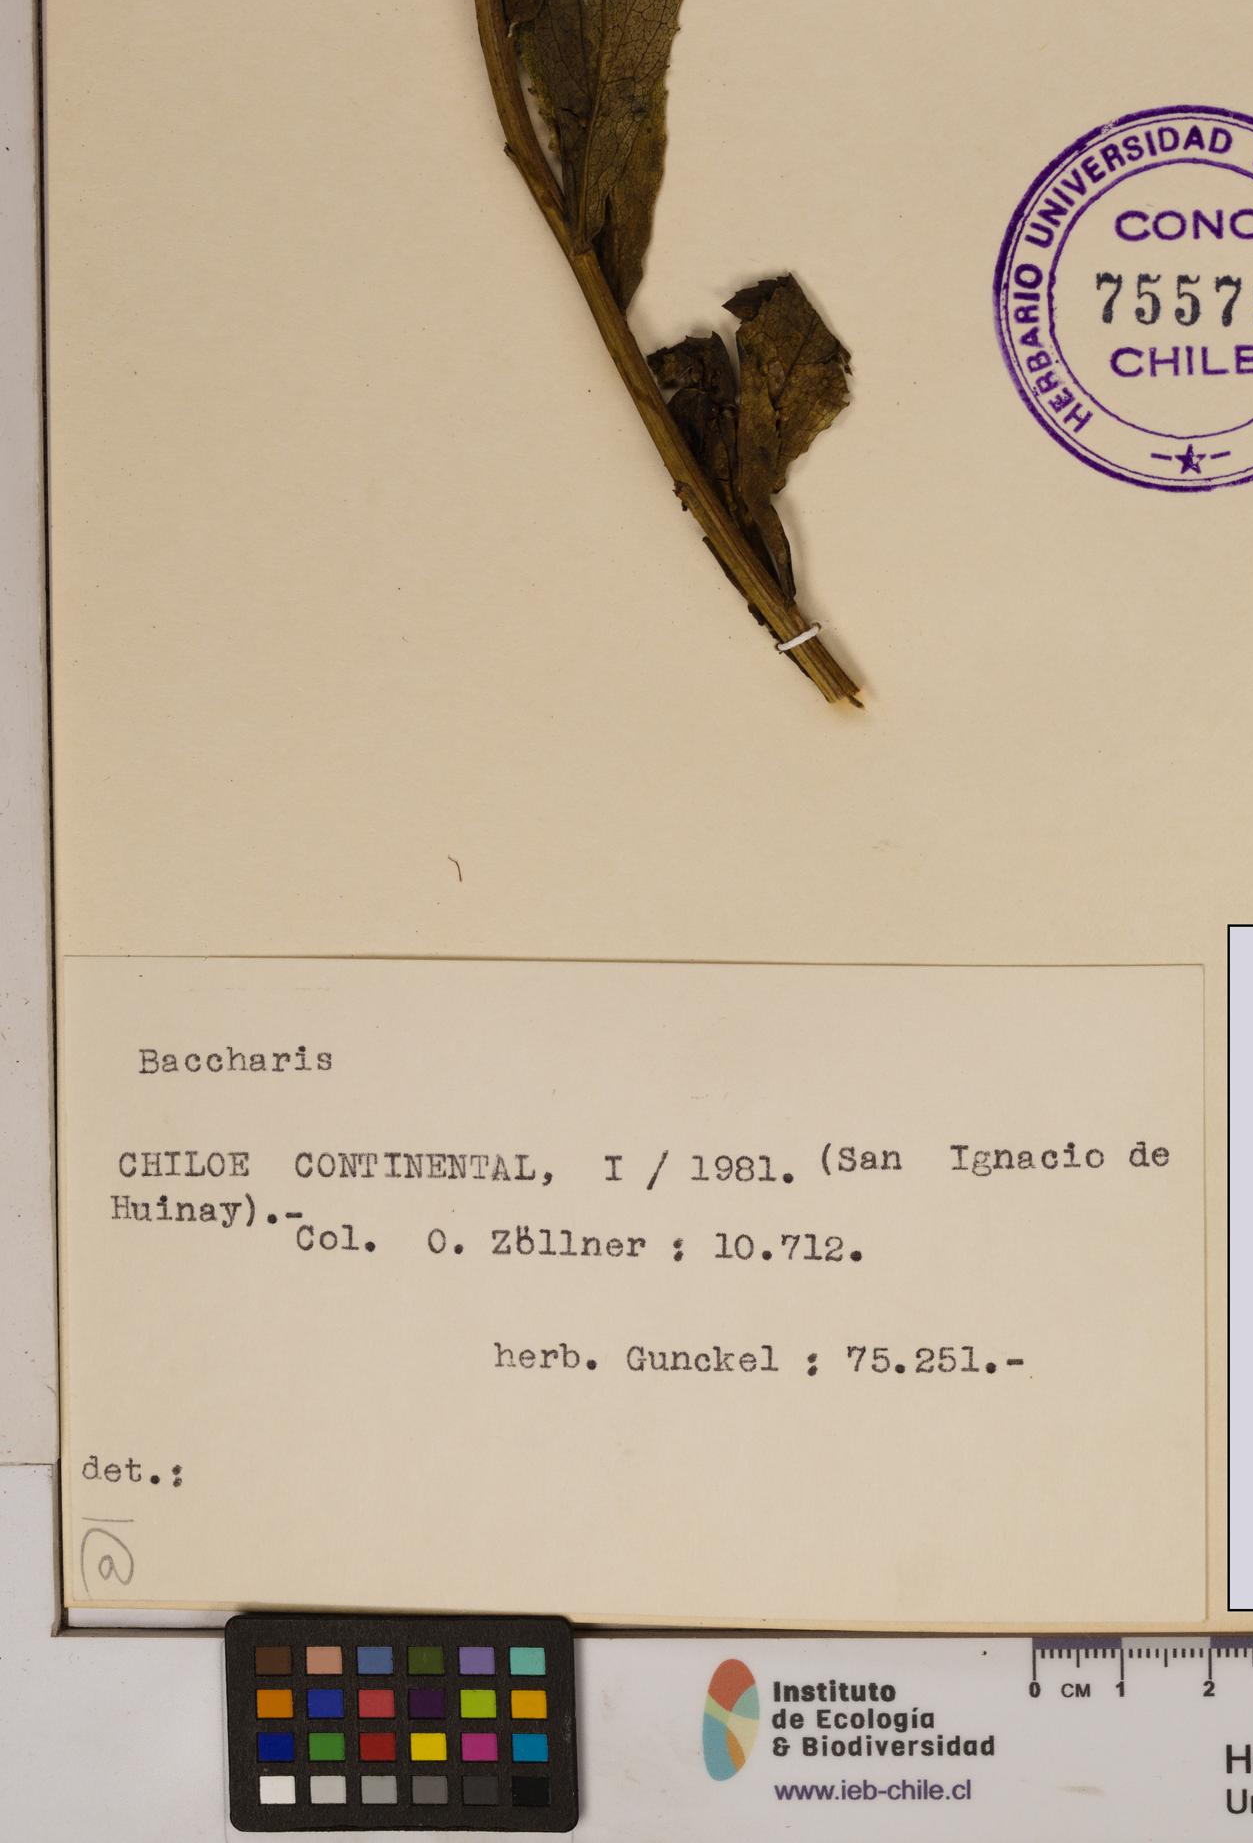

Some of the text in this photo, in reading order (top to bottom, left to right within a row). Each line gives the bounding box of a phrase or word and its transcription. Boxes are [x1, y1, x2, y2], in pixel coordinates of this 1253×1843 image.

[1025, 126, 1232, 248] UNIVERSIDAD
[1014, 263, 1094, 434] HERBARIO
[139, 1046, 331, 1074] Baccharis
[119, 1151, 249, 1178] CHILOE
[295, 1152, 552, 1186] CONTINENTAL,
[605, 1156, 622, 1181] I
[691, 1155, 793, 1184] 1981.
[822, 1143, 902, 1175] (San
[950, 1142, 1104, 1176] Ignacio
[1129, 1141, 1169, 1167] de
[110, 1192, 304, 1229] Huinay).-
[297, 1225, 375, 1252] Col.
[428, 1229, 463, 1254] O.
[492, 1225, 646, 1257] Zöllner
[715, 1233, 862, 1262] 10.712.
[494, 1342, 597, 1370] herb.
[627, 1345, 778, 1372] Gunckel
[847, 1346, 1024, 1374] 75.251.-
[82, 1455, 182, 1487] det.:
[774, 1680, 896, 1702] Instituto
[1027, 1680, 1041, 1699] 0
[1059, 1680, 1092, 1699] CM
[1114, 1679, 1127, 1699] 1
[1202, 1679, 1216, 1699] 2
[772, 1707, 934, 1733] de Ecología
[773, 1735, 994, 1756] & Biodiversidad
[774, 1779, 971, 1800] www.ieb-chile.cl
